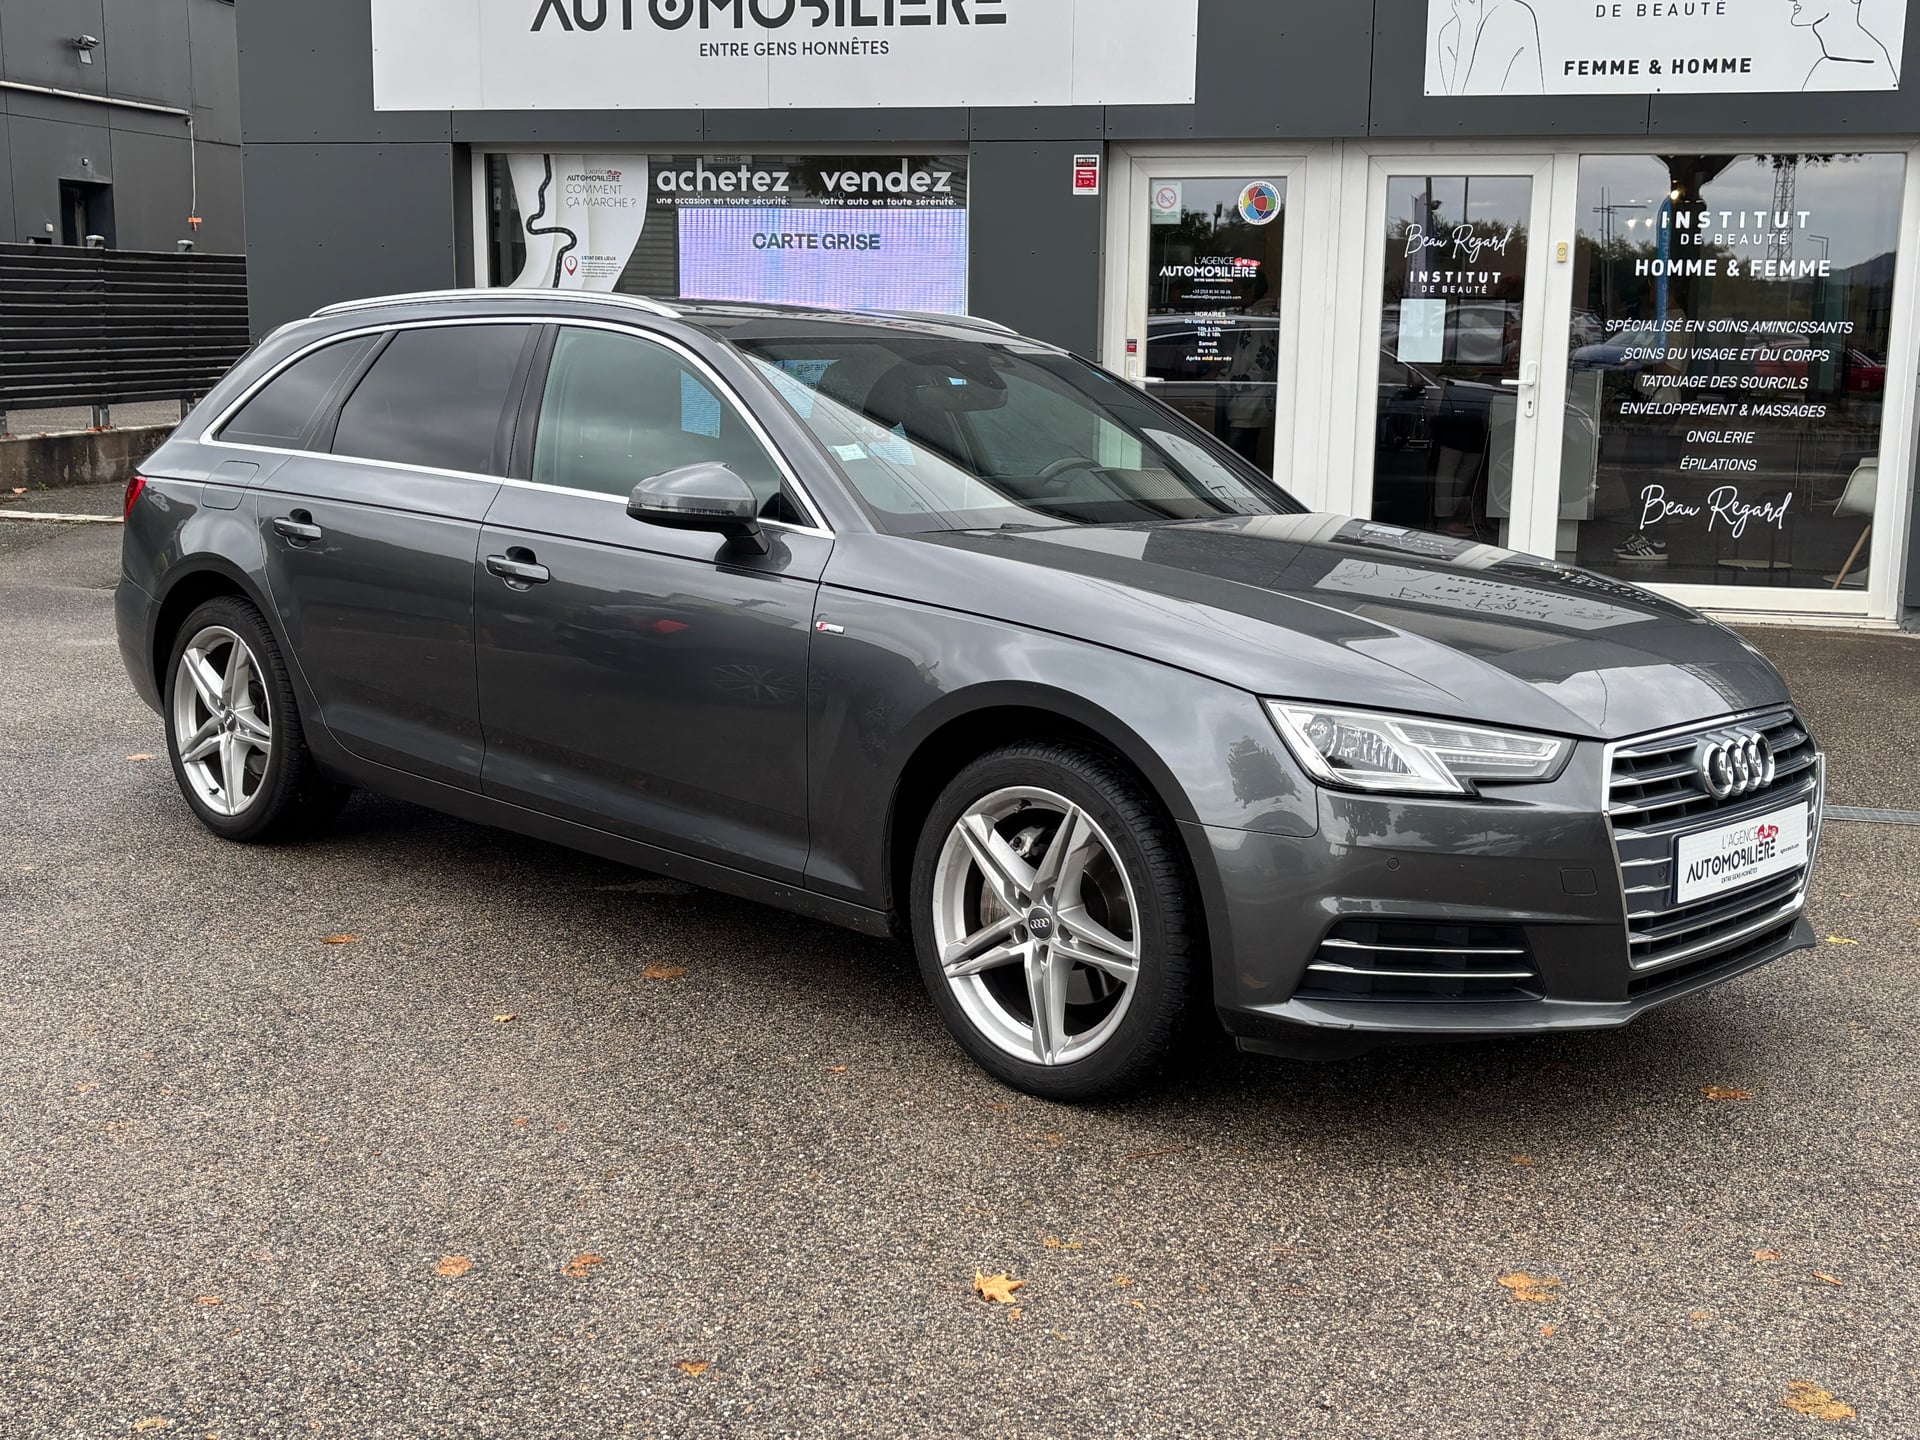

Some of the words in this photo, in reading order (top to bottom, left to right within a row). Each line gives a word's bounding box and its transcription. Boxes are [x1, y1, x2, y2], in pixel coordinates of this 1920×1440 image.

[1595, 4, 1622, 18] DE
[1636, 0, 1726, 17] BEAUTÉ
[700, 42, 749, 57] ENTRE
[754, 42, 797, 56] GENS
[802, 36, 889, 56] HONNÊTES
[1564, 60, 1640, 76] FEMME
[1648, 59, 1662, 75] &
[1671, 58, 1752, 74] HOMME
[656, 158, 790, 192] achetez
[820, 158, 953, 193] vendez
[566, 184, 623, 194] COMMENT
[566, 196, 580, 208] ÇA
[582, 197, 628, 208] MARCHE
[630, 198, 636, 208] ?
[674, 196, 711, 205] occasion
[726, 196, 750, 206] toute
[820, 197, 844, 206] votre
[846, 198, 869, 206] auto
[886, 197, 913, 206] toute
[1662, 211, 1812, 229] INSTITUT
[752, 232, 818, 250] CARTE
[822, 233, 881, 250] GRISE
[1404, 224, 1447, 258] Beau
[1452, 224, 1512, 263] Regard
[1680, 234, 1703, 245] DE
[1714, 231, 1788, 245] BEAUTÉ
[1194, 256, 1234, 265] L'AGENCE
[1634, 259, 1718, 277] HOMME
[1726, 259, 1740, 277] &
[1750, 259, 1831, 277] FEMME
[1410, 271, 1502, 284] INSTITUT
[1442, 284, 1488, 294] BEAUTÉ
[1605, 317, 1684, 332] SPÉCIALISÉ
[1684, 320, 1704, 332] EN
[1706, 320, 1748, 333] SOINS
[1750, 320, 1854, 334] AMINCISSANTS
[1624, 347, 1664, 360] SOINS
[1668, 348, 1687, 360] DU
[1690, 348, 1737, 361] VISAGE
[1740, 349, 1757, 361] ET
[1760, 349, 1780, 362] DU
[1782, 349, 1830, 362] CORPS
[1642, 375, 1707, 388] TATOUAGE
[1710, 376, 1737, 388] DES
[1740, 376, 1809, 389] SOURCILS
[1620, 402, 1737, 416] ENVELOPPEMENT
[1739, 404, 1748, 416] &
[1752, 404, 1826, 417] MASSAGES
[1686, 431, 1755, 444] ONGLERIE
[1680, 455, 1758, 471] ÉPILATIONS
[1639, 484, 1700, 530] Beau
[1707, 485, 1792, 539] Regard
[1722, 825, 1758, 849] L'AGENCE
